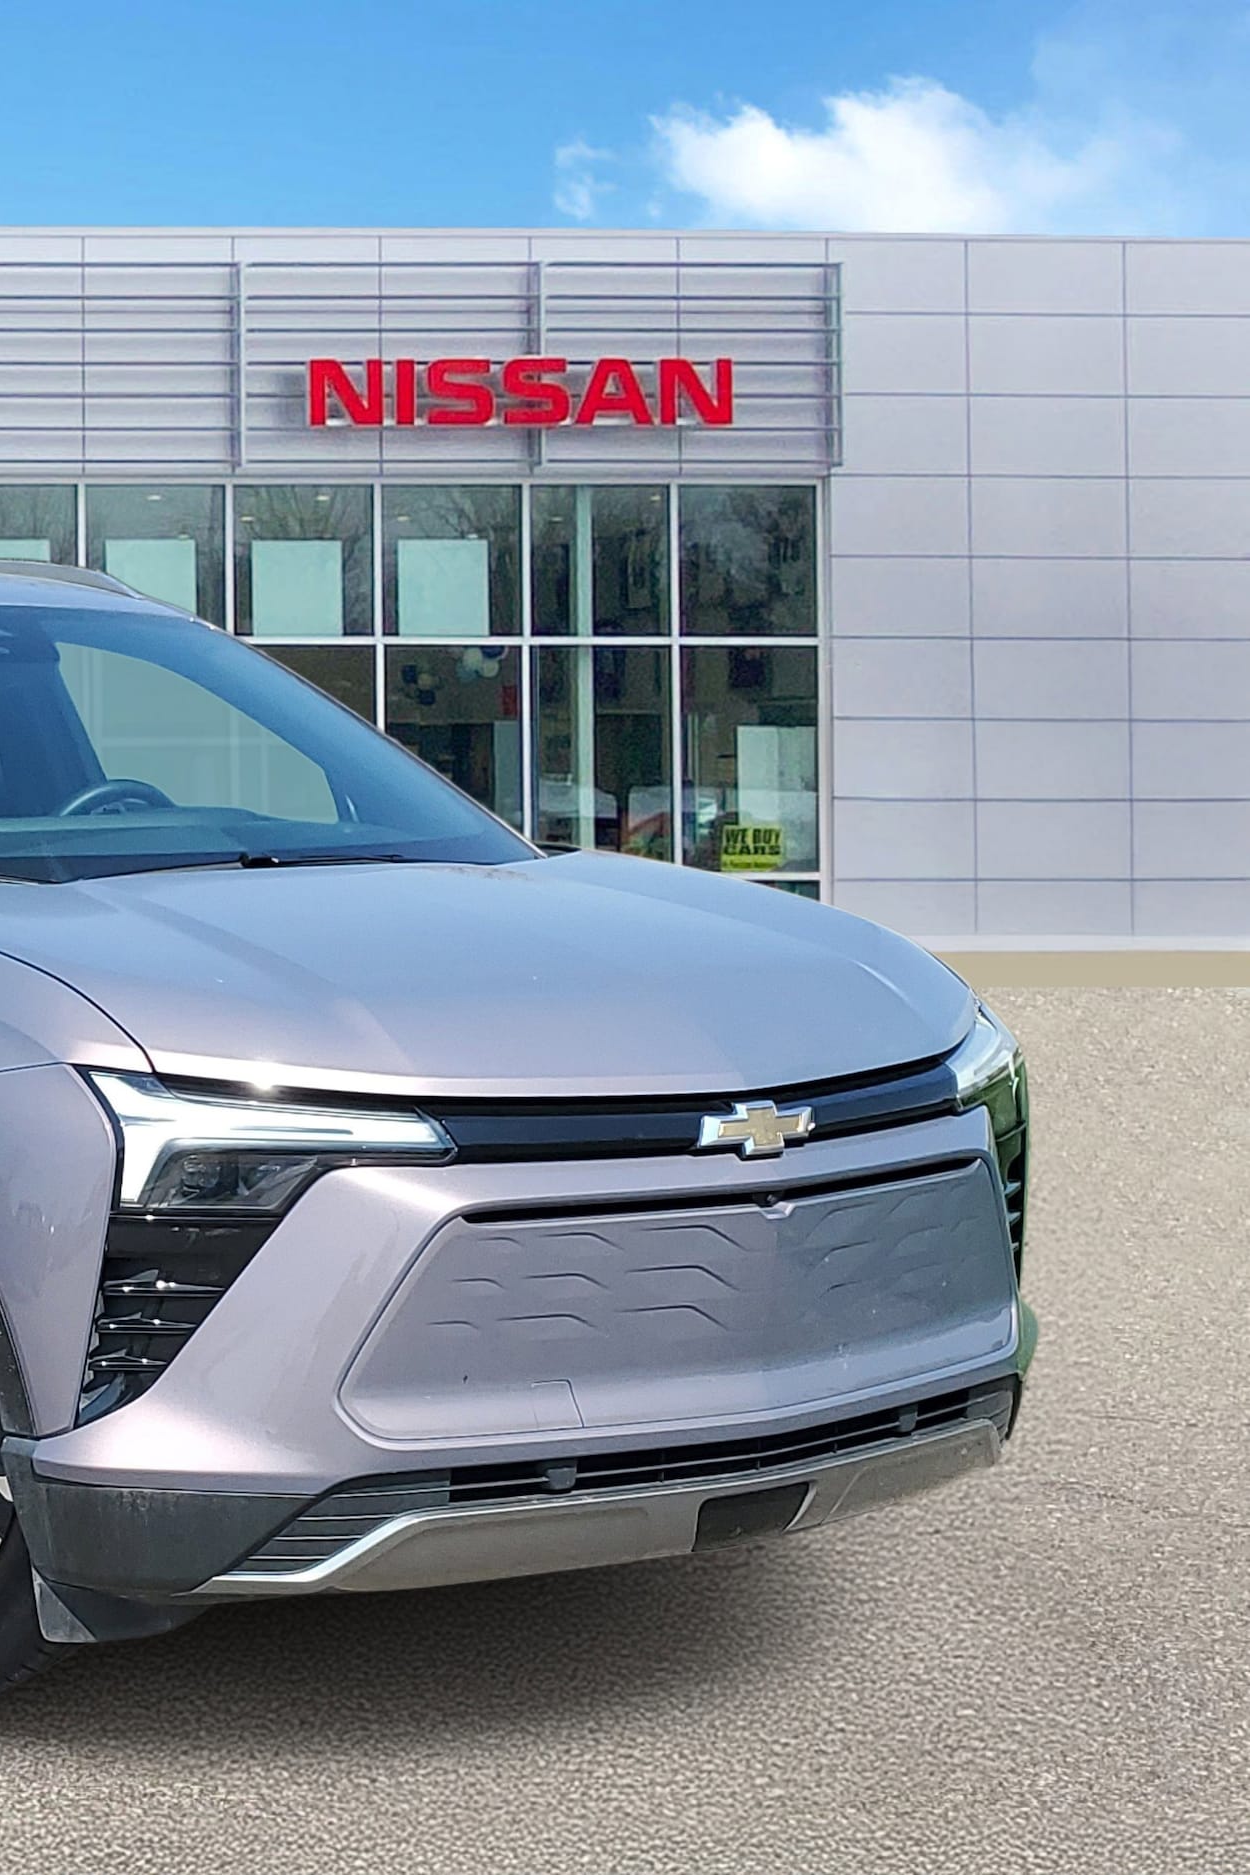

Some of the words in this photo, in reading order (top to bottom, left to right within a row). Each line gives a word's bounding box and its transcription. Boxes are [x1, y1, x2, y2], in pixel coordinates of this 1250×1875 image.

[307, 358, 734, 426] NISSAN
[725, 828, 748, 844] WE
[752, 828, 781, 844] BUY
[723, 845, 781, 856] CARS
